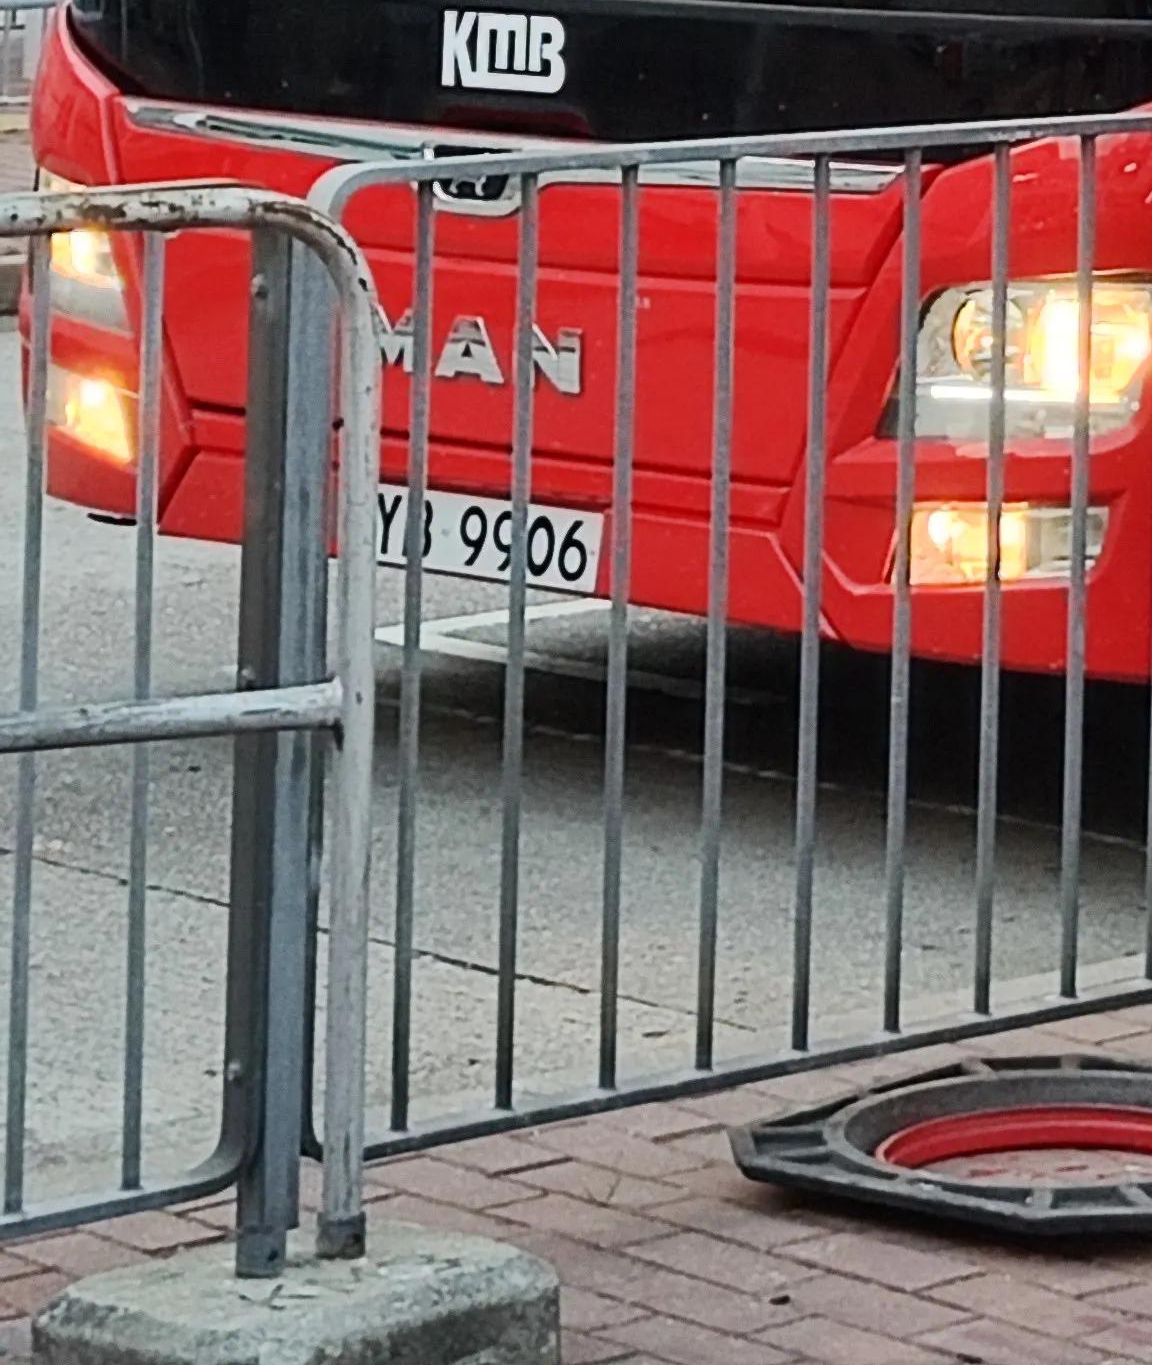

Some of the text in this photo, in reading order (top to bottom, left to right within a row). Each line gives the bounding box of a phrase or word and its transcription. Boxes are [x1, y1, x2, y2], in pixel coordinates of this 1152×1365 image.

[442, 11, 566, 94] KMB
[374, 301, 582, 395] MAN
[460, 505, 588, 582] 9906
